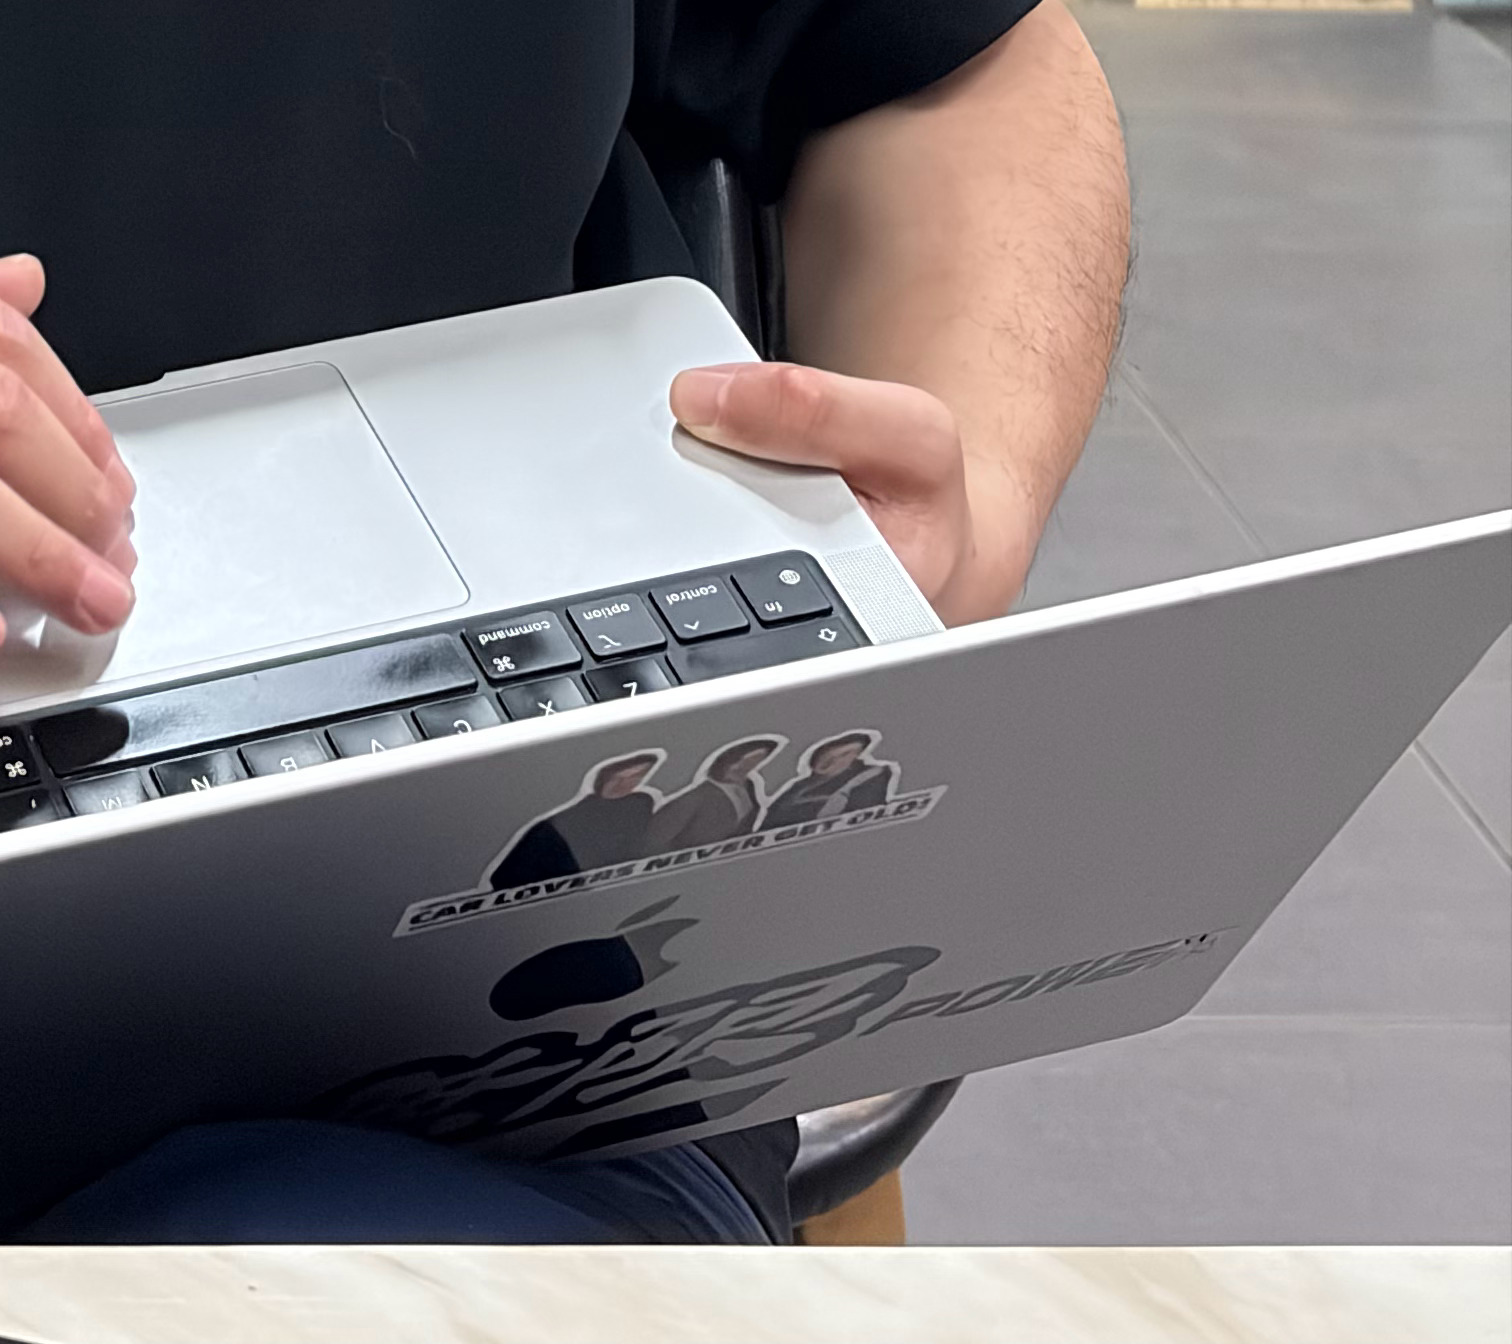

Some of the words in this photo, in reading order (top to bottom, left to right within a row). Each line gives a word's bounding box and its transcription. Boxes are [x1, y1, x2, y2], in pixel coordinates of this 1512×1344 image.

[665, 584, 718, 606] control
[582, 602, 631, 621] option
[478, 620, 551, 646] command
[643, 836, 766, 873] NEVER
